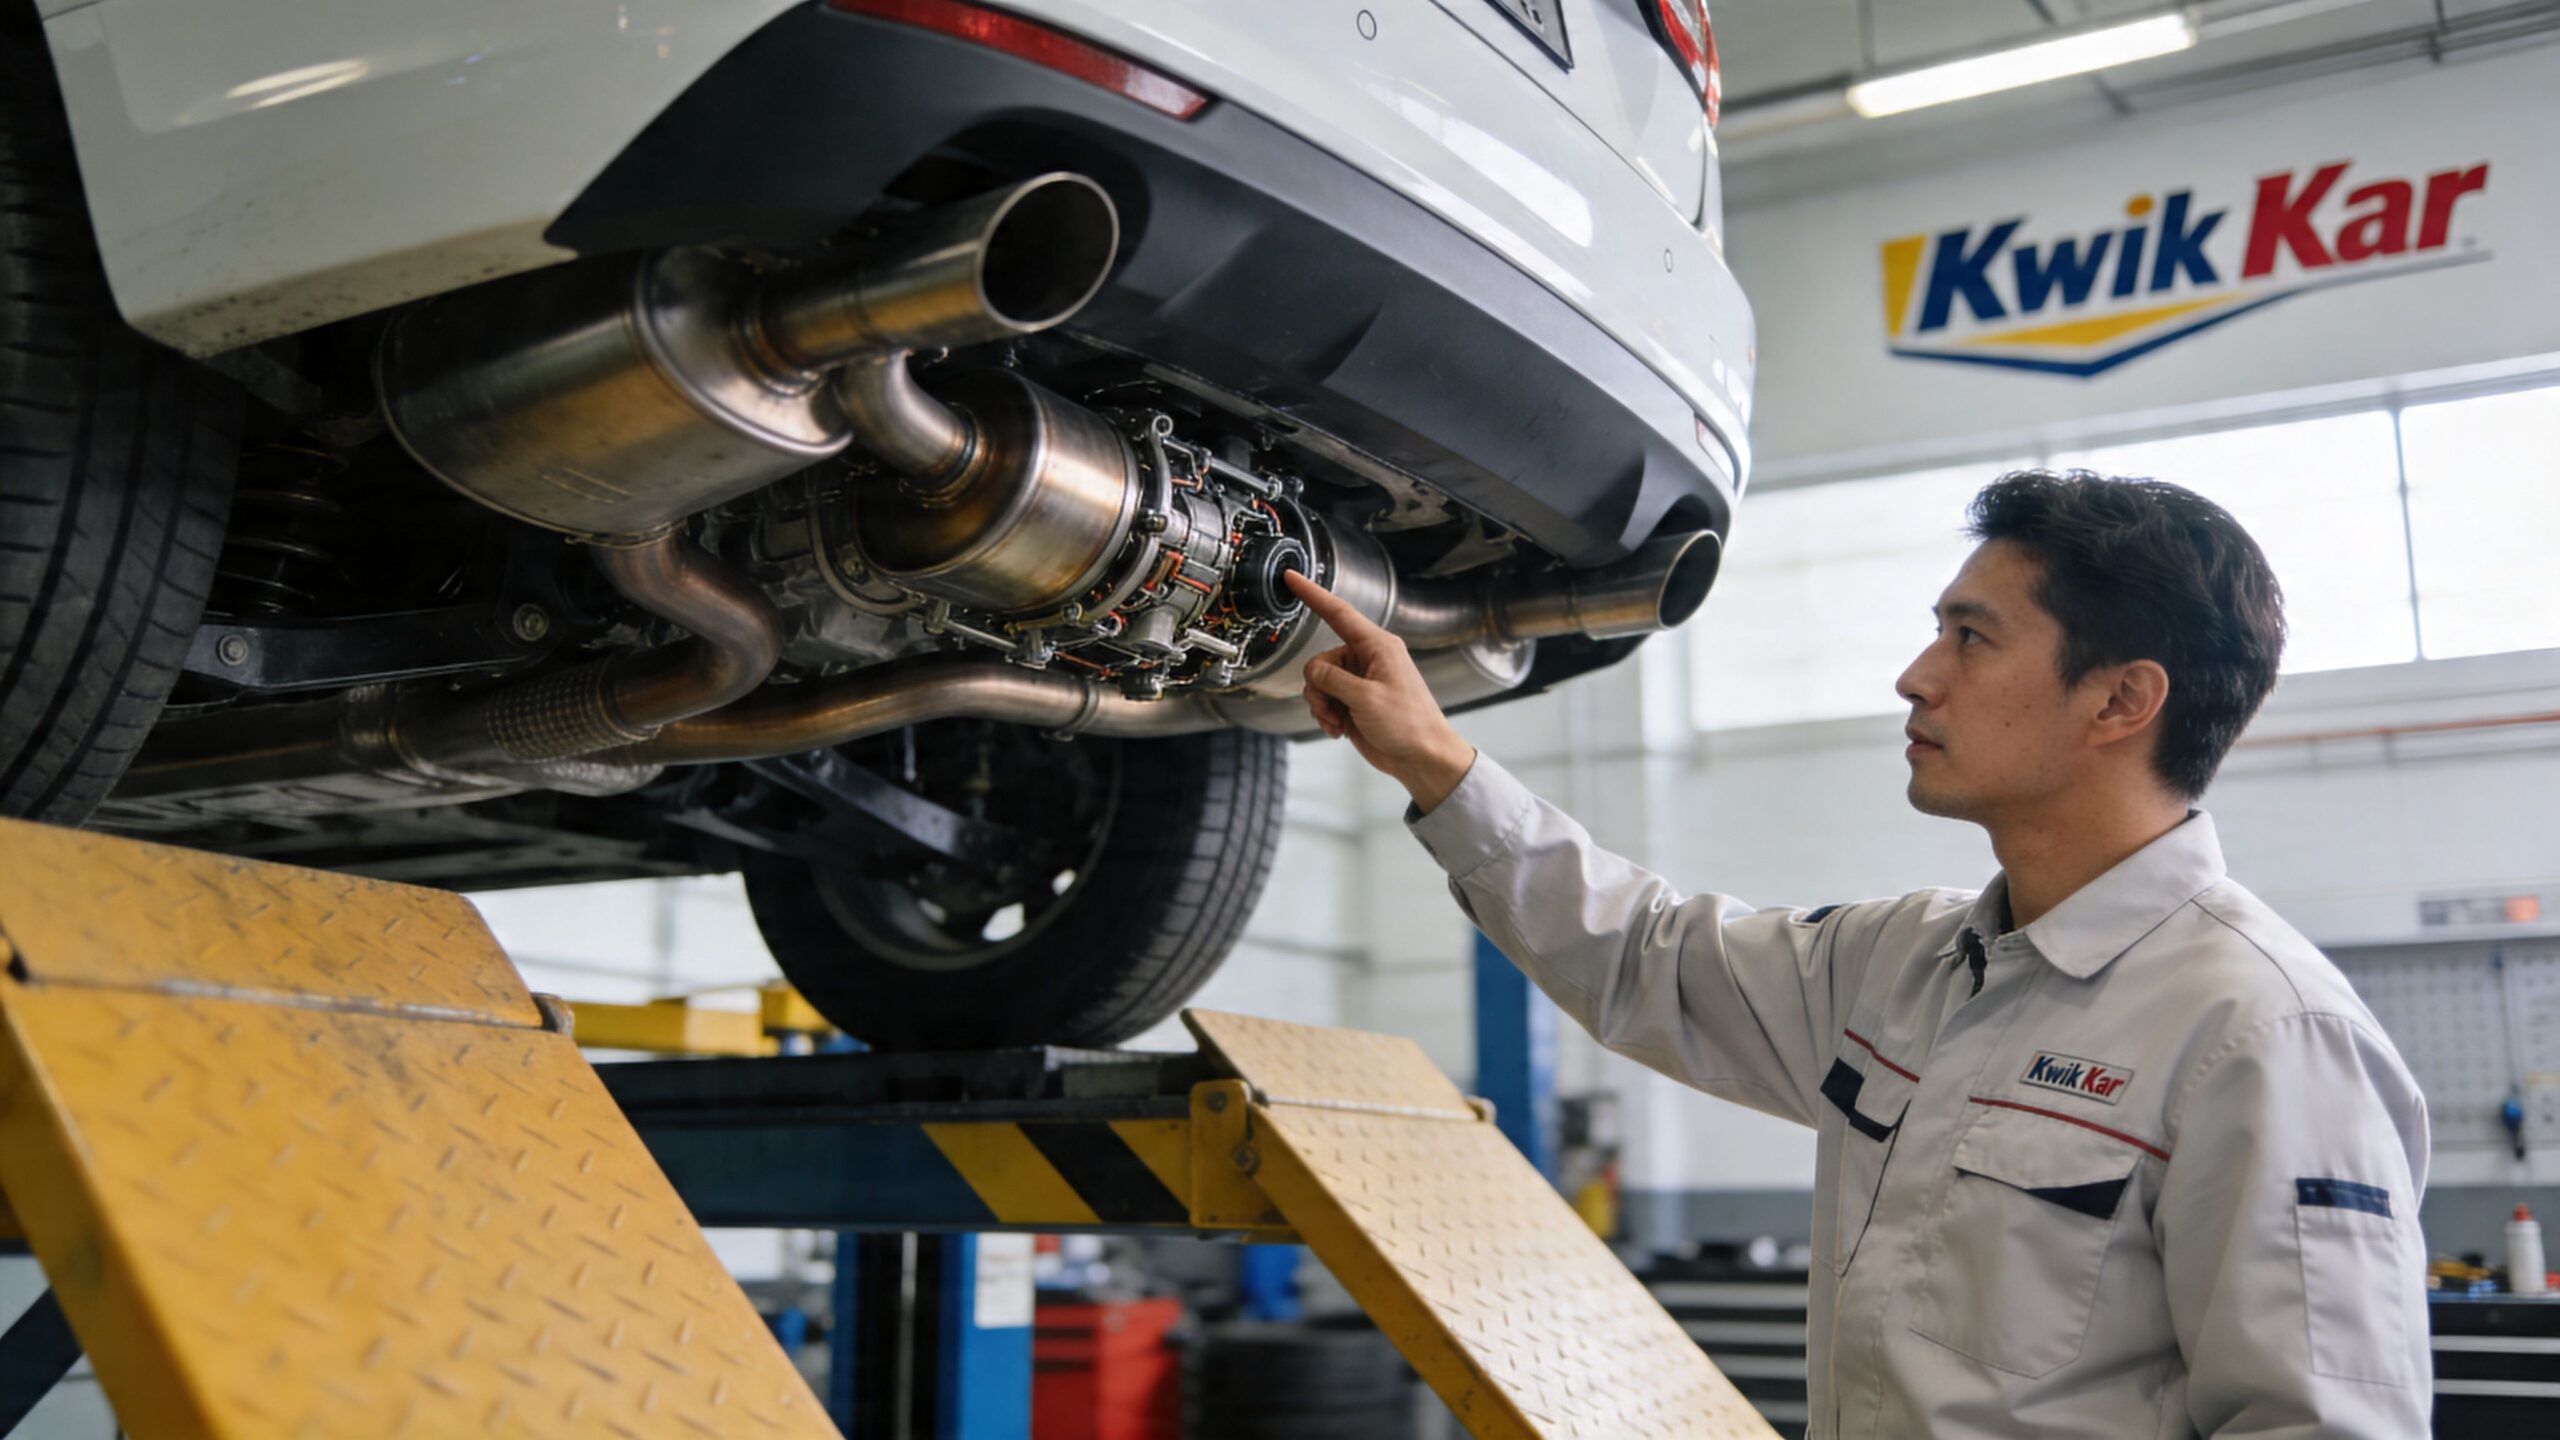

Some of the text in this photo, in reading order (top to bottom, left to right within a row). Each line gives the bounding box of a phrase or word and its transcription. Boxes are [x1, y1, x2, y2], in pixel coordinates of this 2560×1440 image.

[1917, 158, 2490, 333] Kwik Kar
[2028, 1055, 2125, 1097] Kwik Kar
